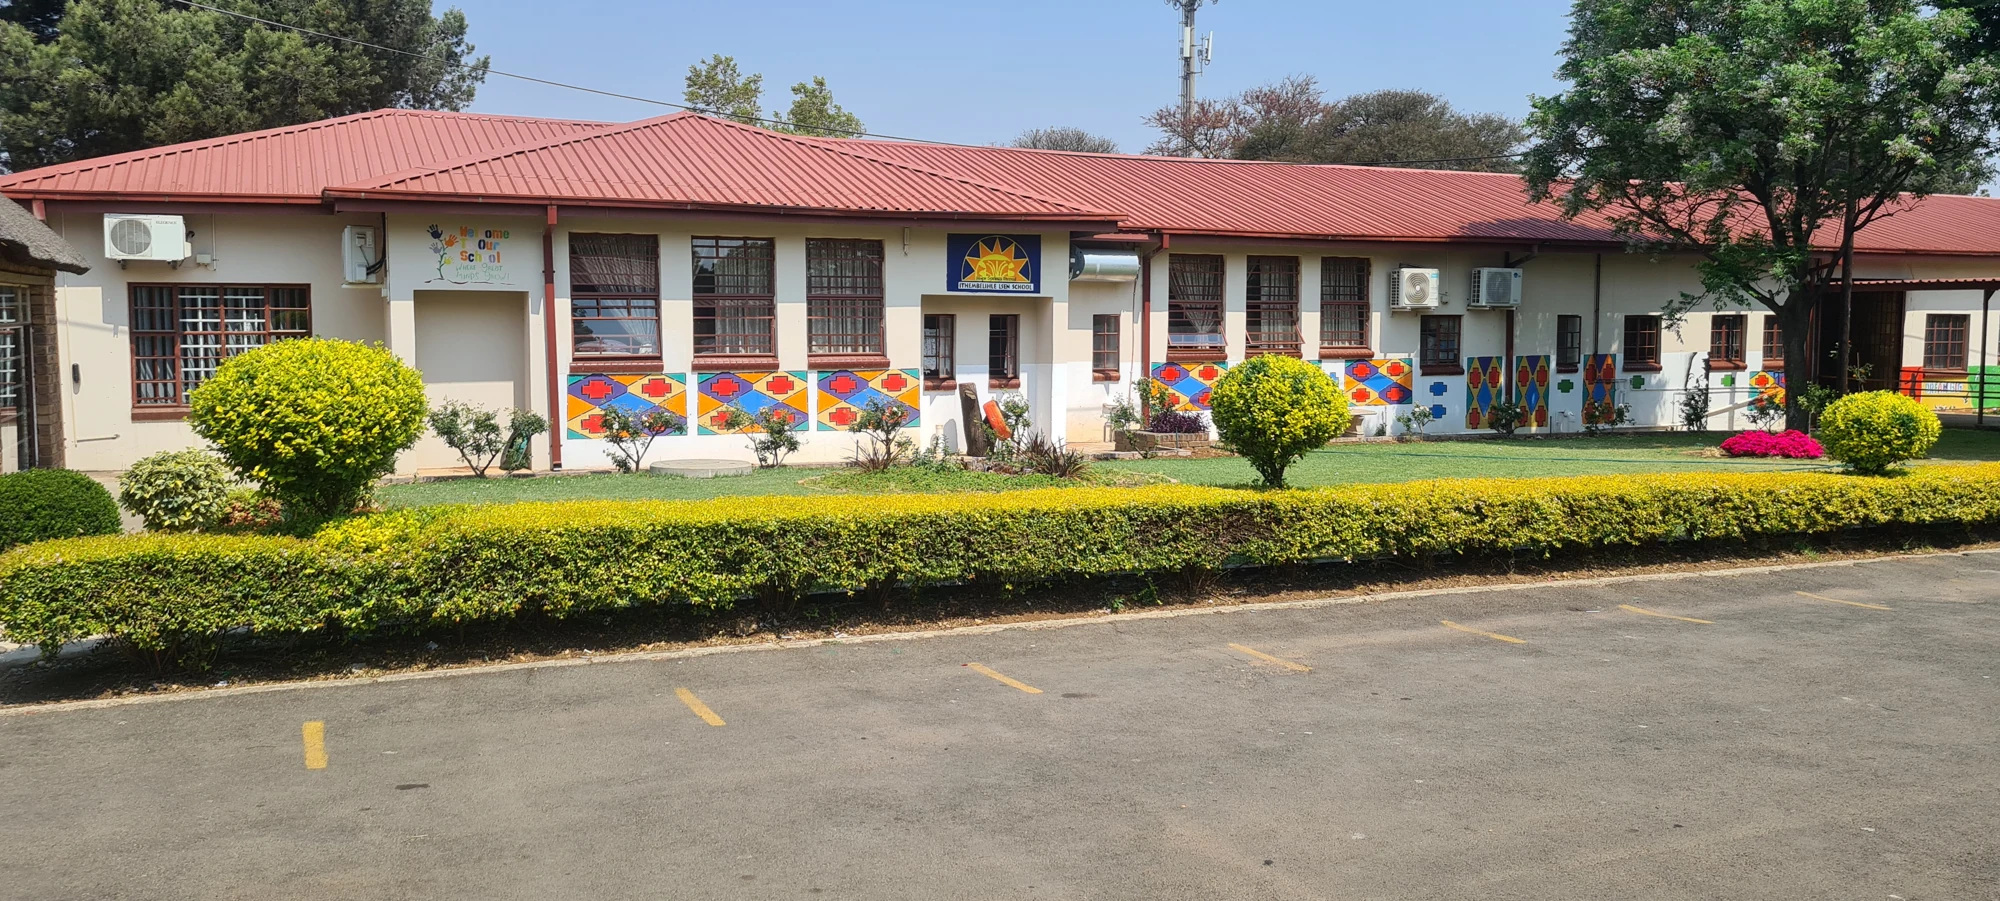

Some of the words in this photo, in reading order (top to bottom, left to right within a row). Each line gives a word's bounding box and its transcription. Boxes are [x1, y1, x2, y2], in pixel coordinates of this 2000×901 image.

[460, 226, 510, 239] Welome
[478, 239, 500, 251] Our
[460, 250, 501, 264] Schol
